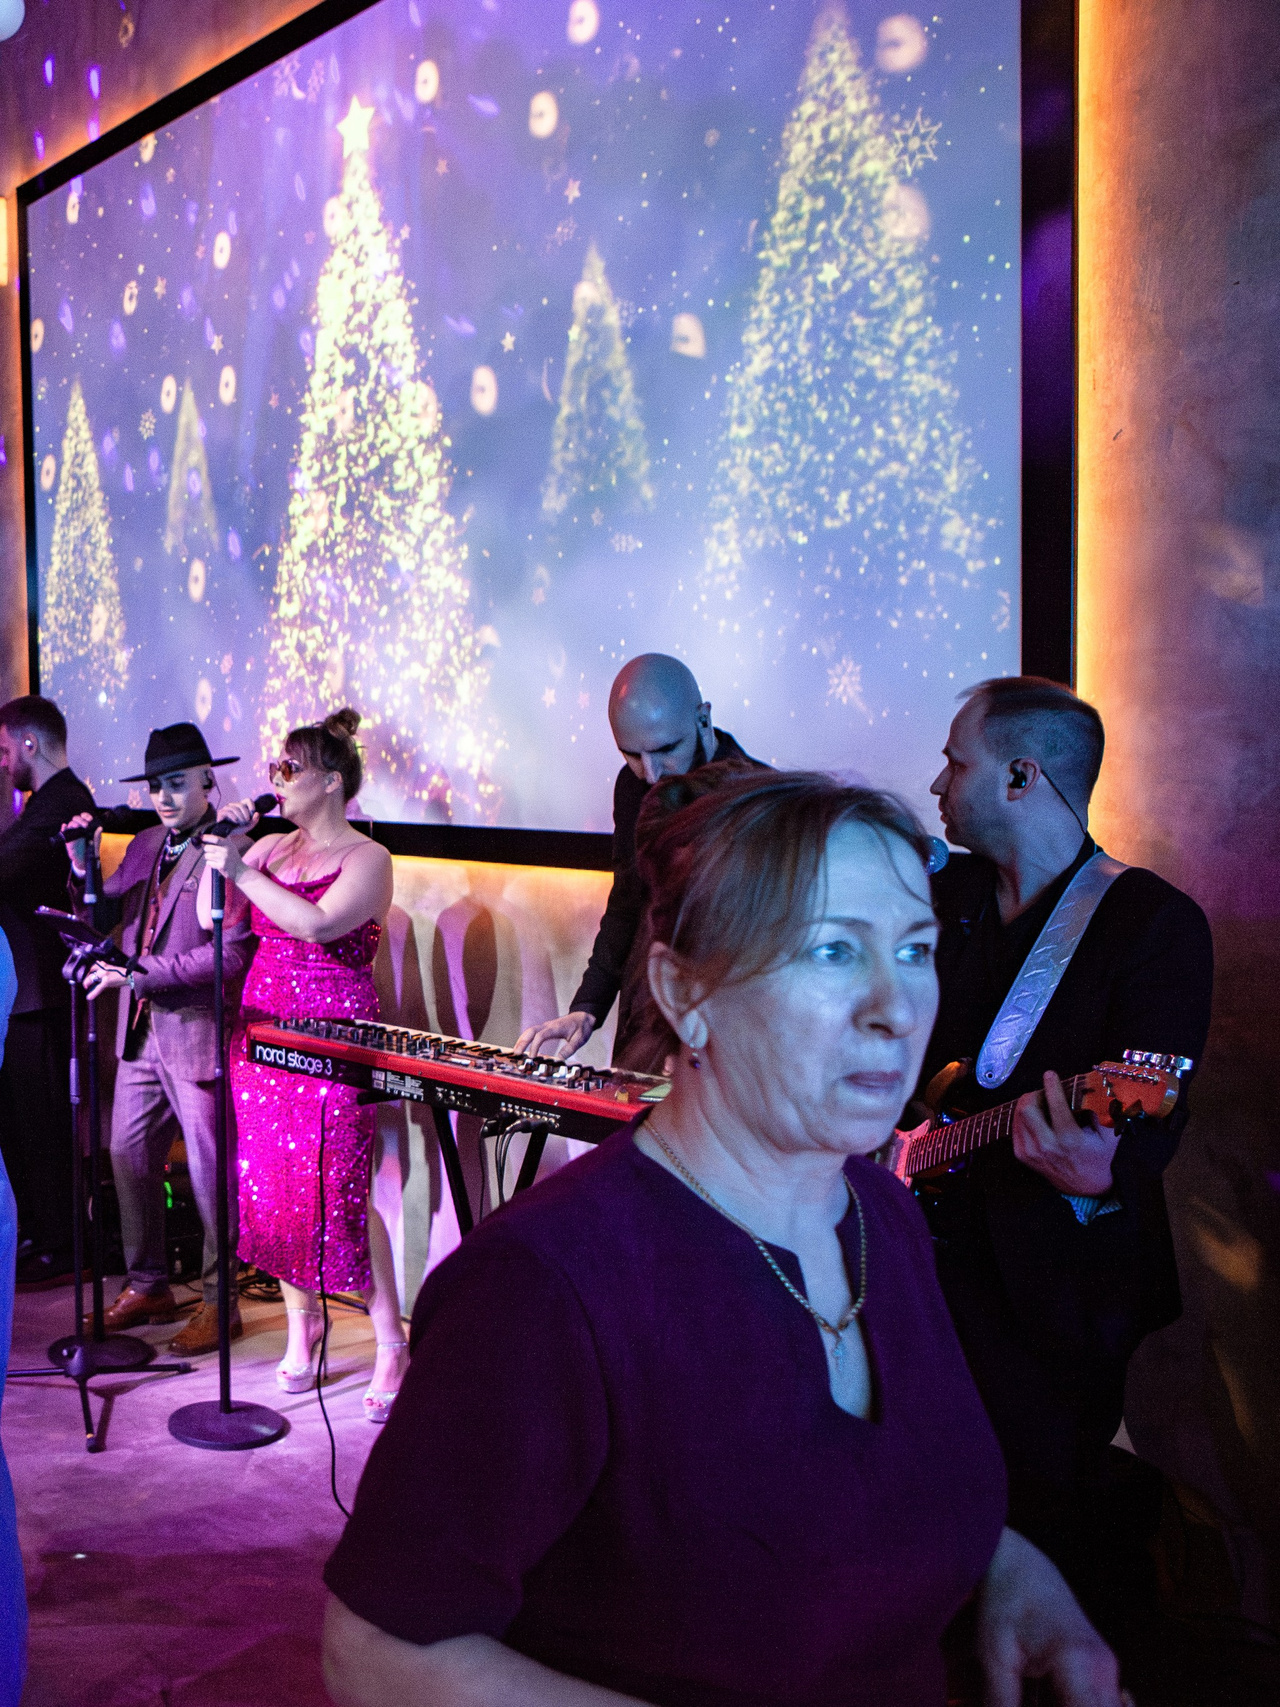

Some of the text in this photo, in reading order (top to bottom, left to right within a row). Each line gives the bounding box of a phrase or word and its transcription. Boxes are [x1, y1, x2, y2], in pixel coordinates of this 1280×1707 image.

[256, 1045, 332, 1075] nord stage 3
